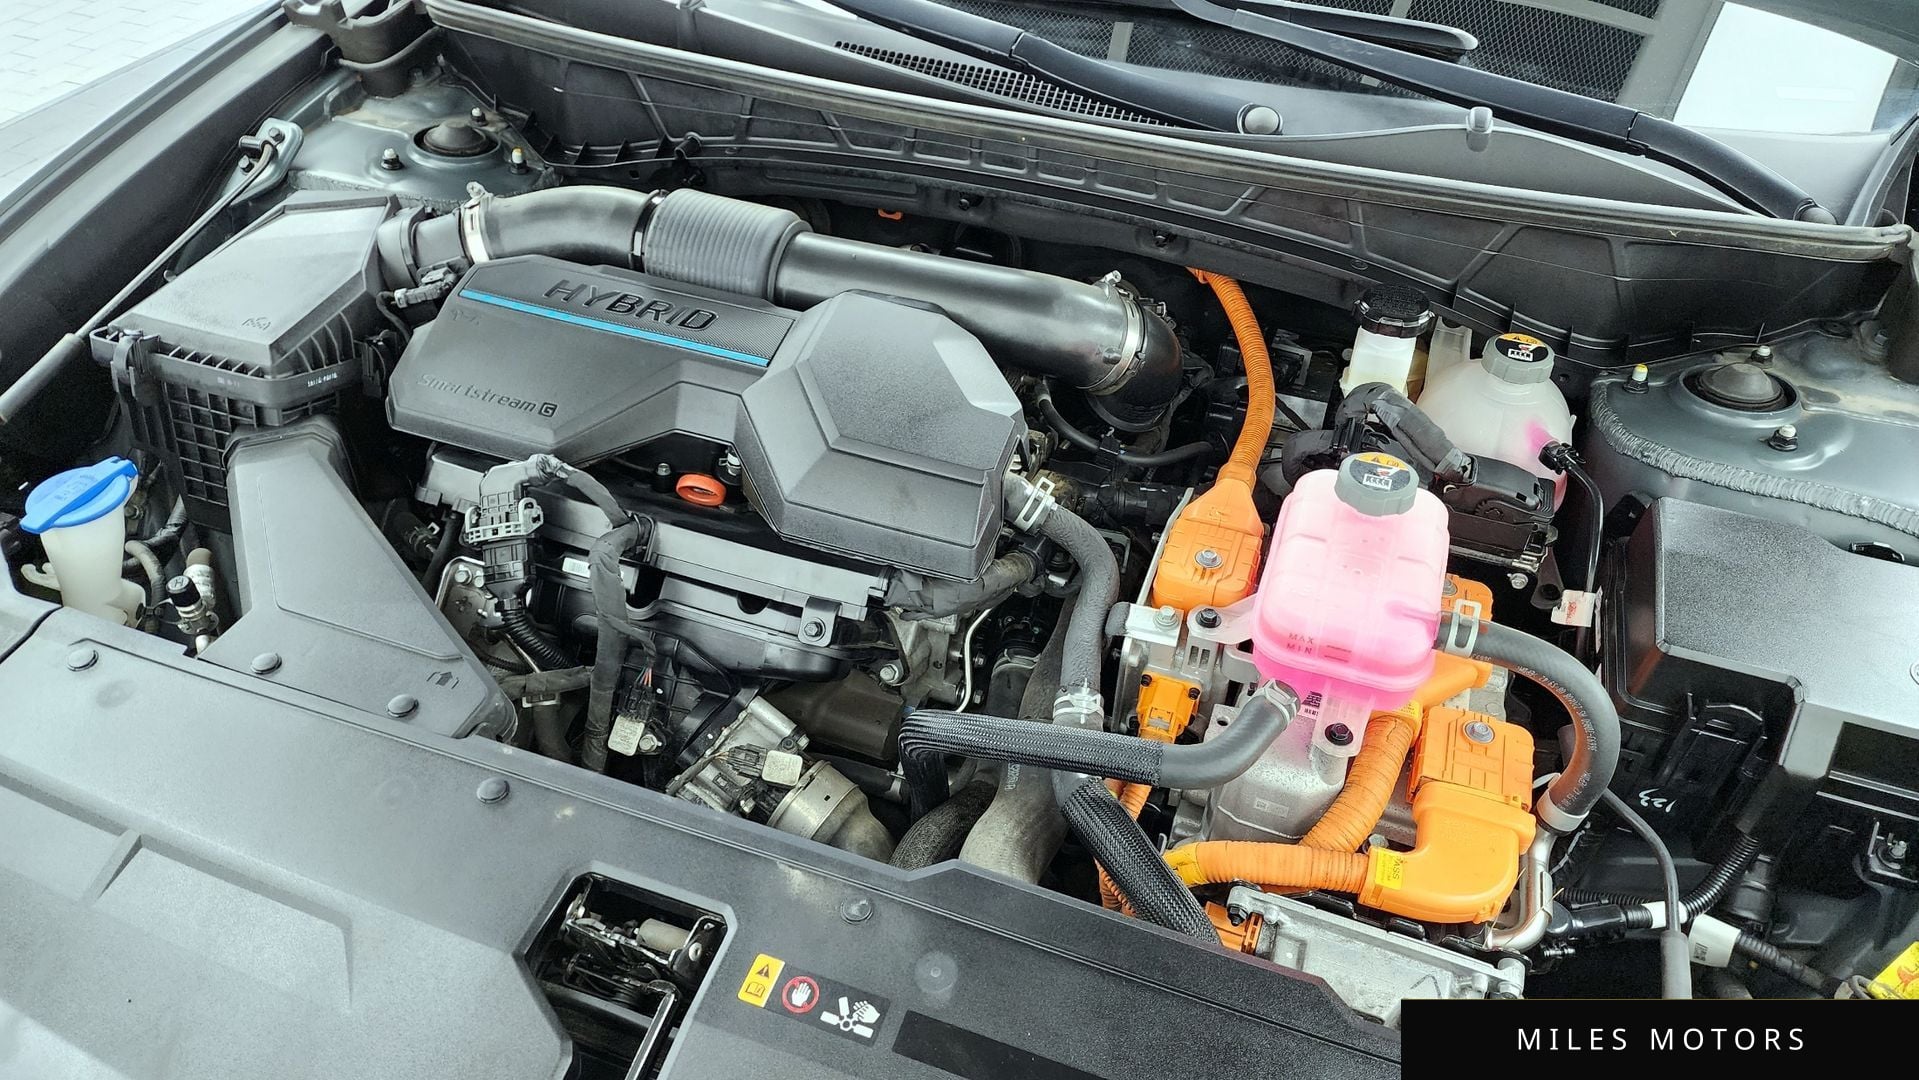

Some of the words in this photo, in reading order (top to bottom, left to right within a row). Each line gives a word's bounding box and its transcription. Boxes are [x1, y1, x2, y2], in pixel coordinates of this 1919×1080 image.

[543, 278, 719, 330] HYBRID
[416, 373, 537, 413] Smartstream
[1286, 642, 1313, 655] MIN
[1288, 632, 1314, 645] MAX
